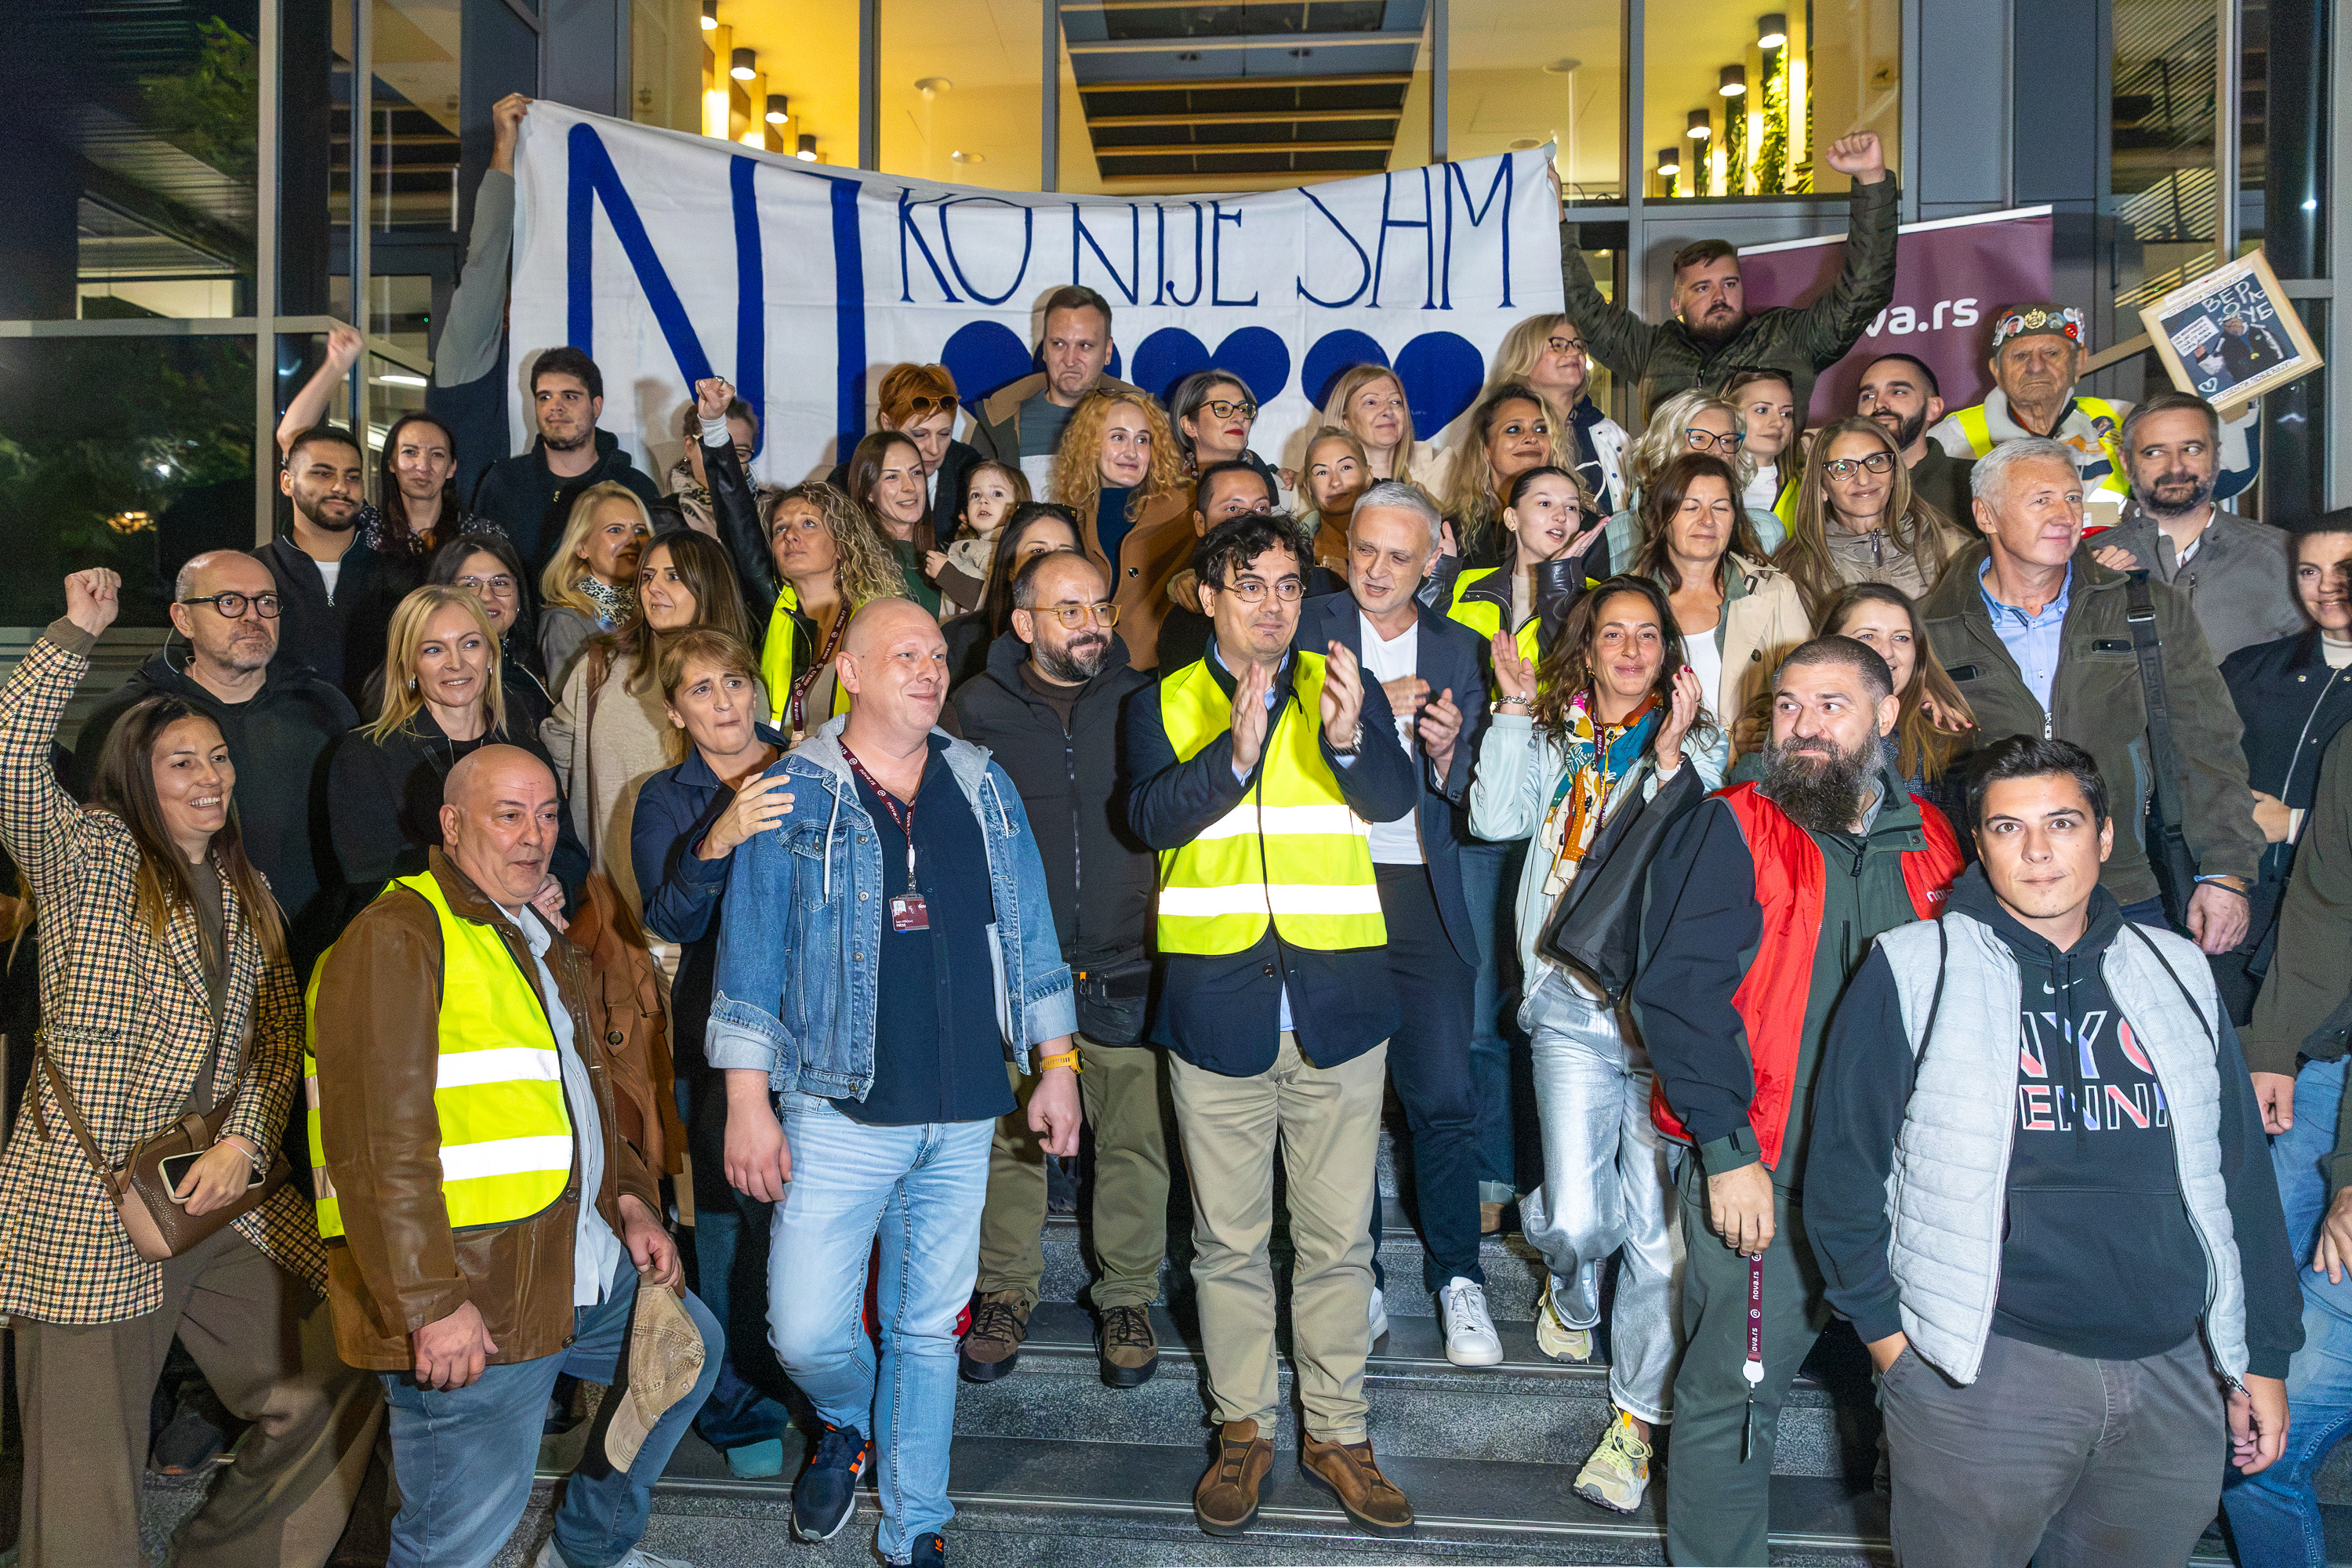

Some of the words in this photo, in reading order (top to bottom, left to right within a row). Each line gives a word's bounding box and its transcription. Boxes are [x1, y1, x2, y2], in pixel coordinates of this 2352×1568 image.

[1067, 200, 1258, 307] NIJE
[1297, 152, 1516, 310] SAM
[858, 768, 877, 786] nova.rs
